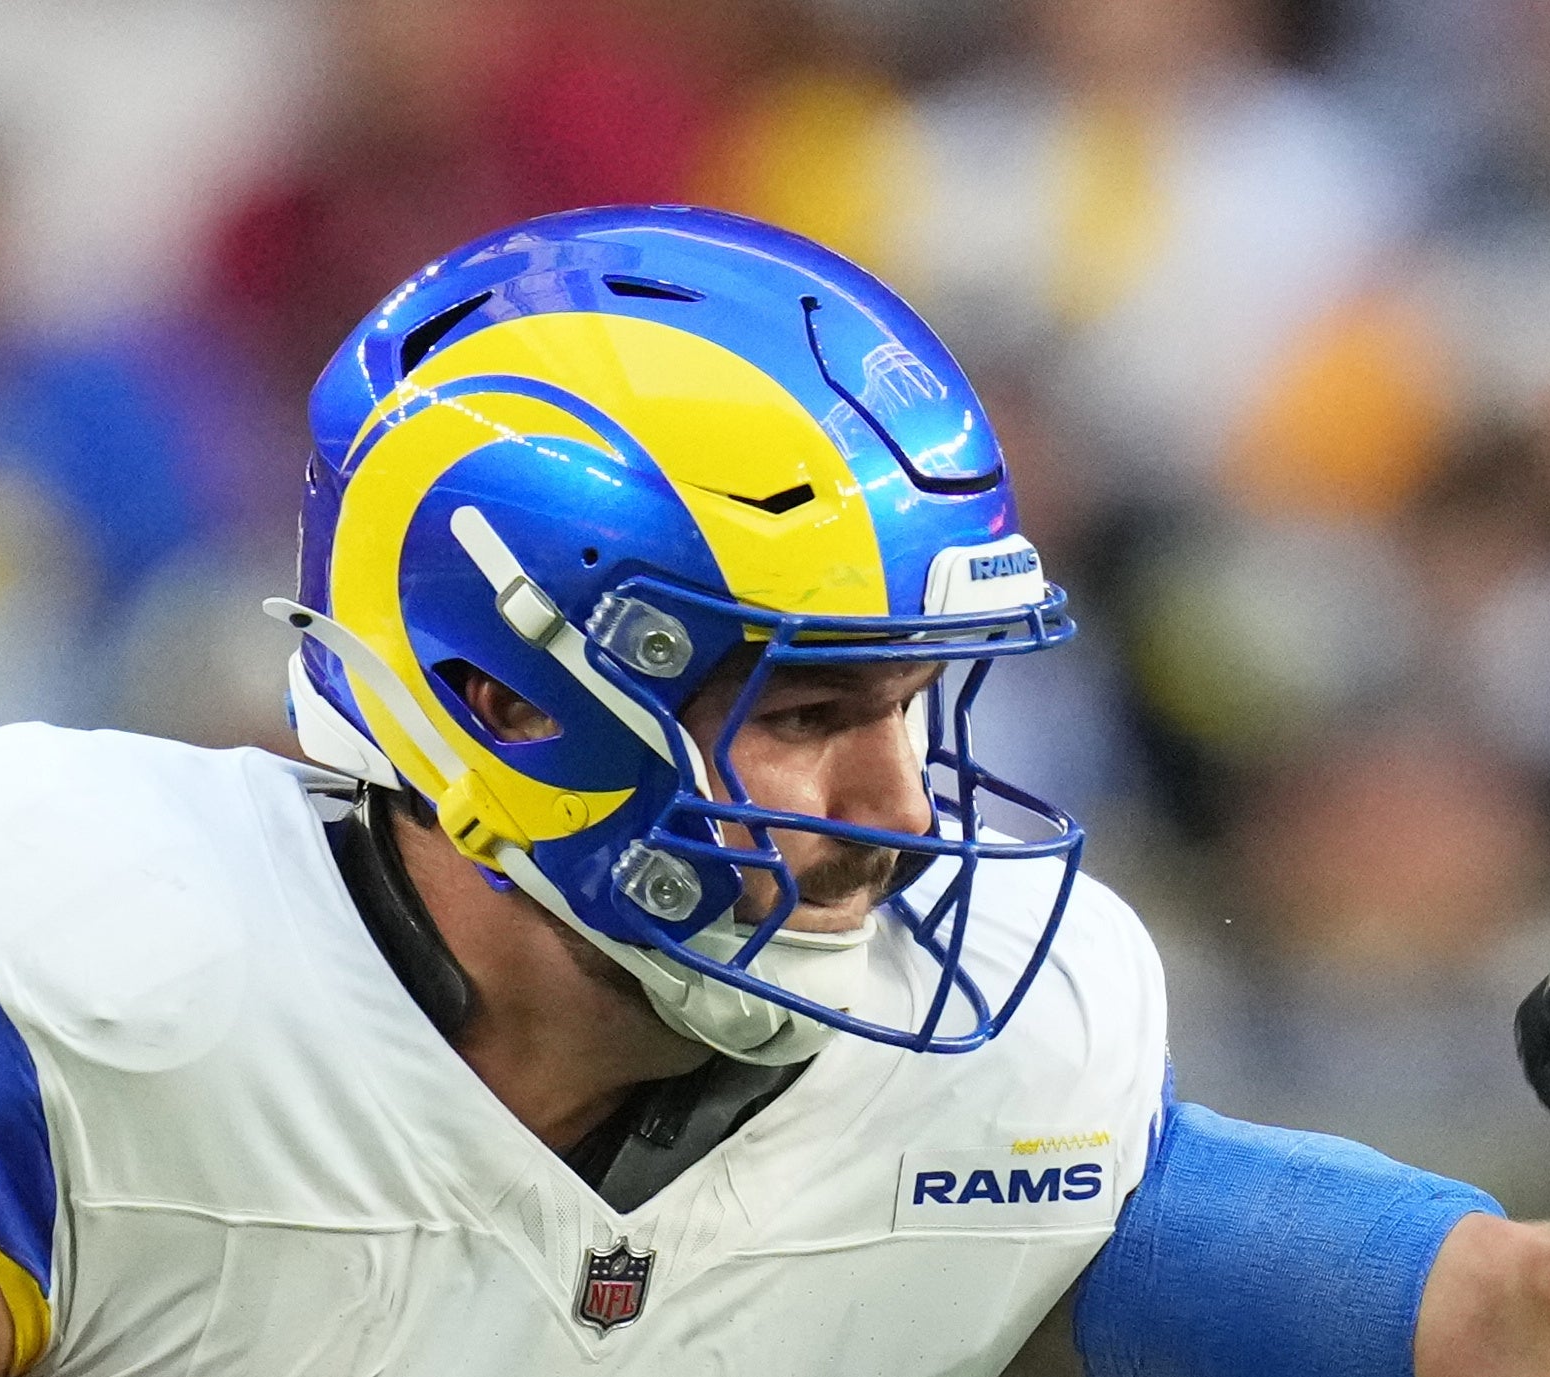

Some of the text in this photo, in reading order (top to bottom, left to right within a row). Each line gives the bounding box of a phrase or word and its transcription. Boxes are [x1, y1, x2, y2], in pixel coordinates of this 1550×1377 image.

[969, 547, 1038, 581] RAMS
[912, 1163, 1103, 1205] RAMS
[586, 1282, 636, 1320] NFL
